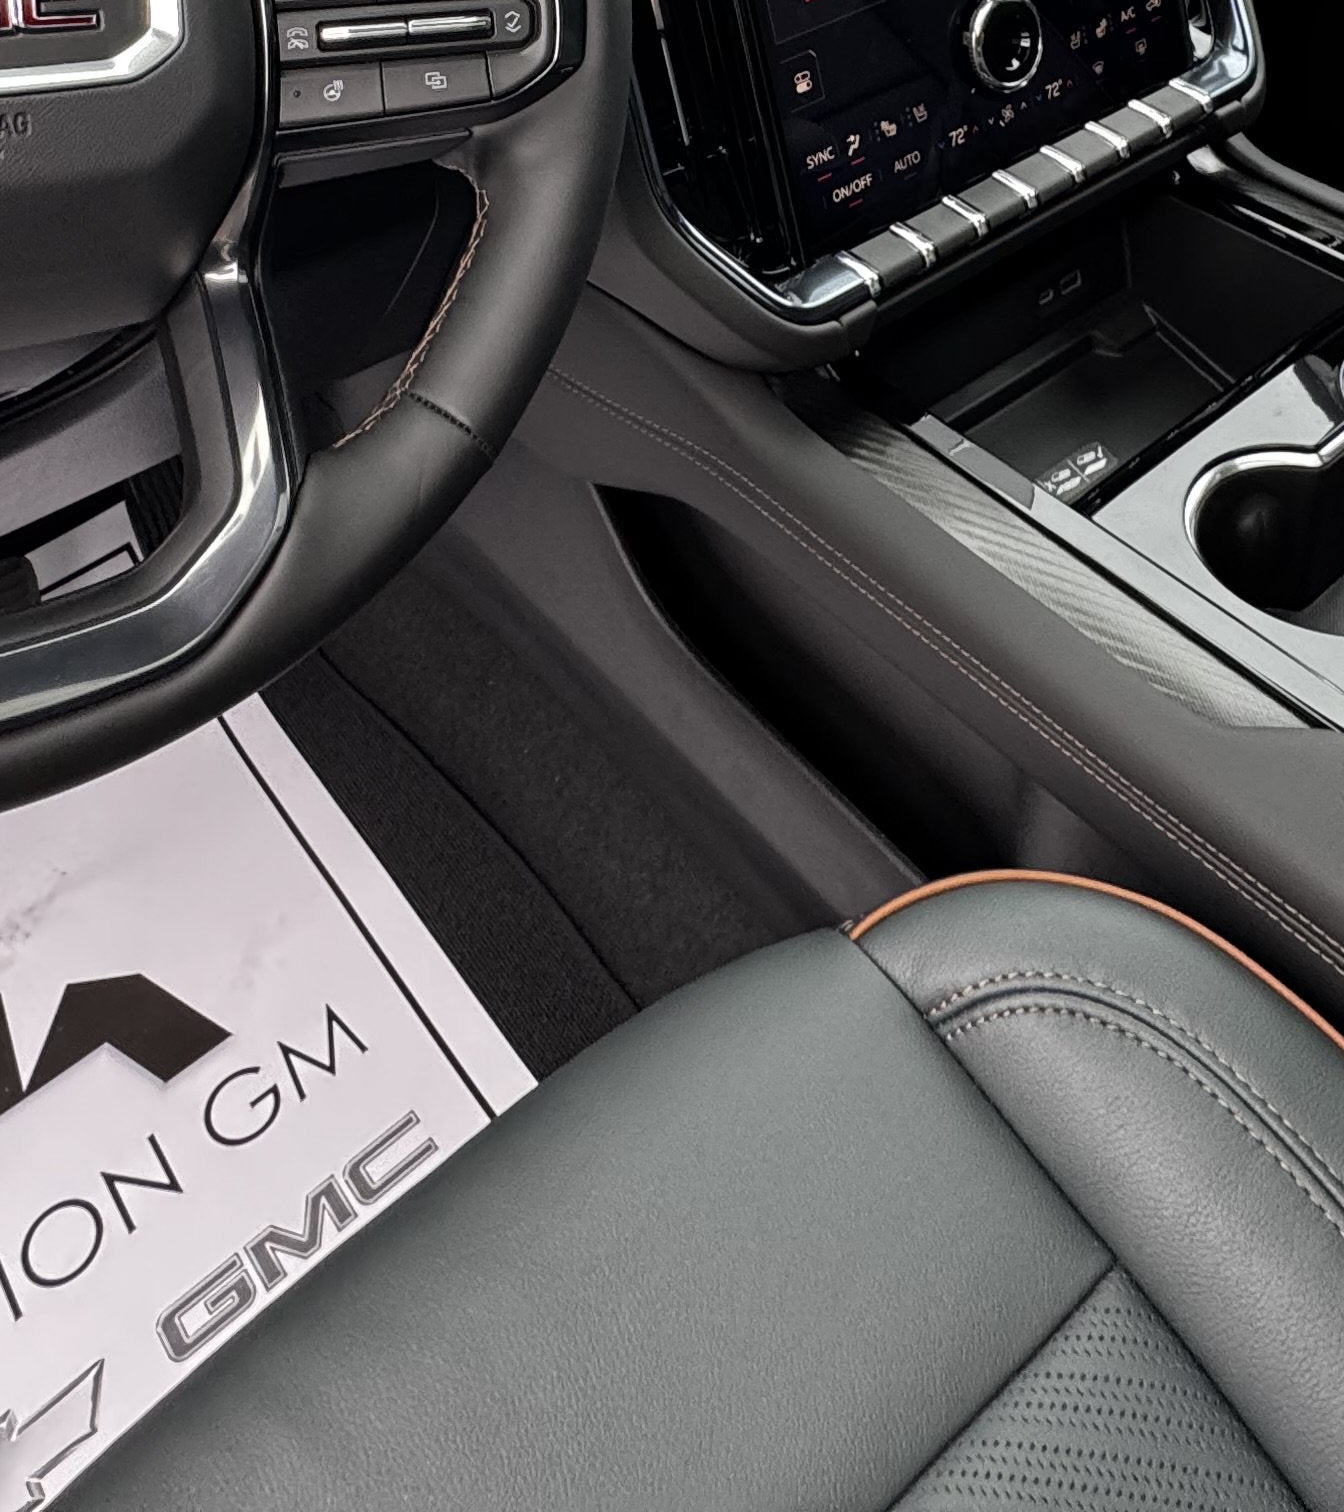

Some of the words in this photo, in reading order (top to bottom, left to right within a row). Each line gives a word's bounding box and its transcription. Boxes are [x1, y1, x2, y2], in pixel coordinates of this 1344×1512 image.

[806, 146, 835, 170] SYNC
[894, 150, 921, 174] AUTO
[832, 173, 873, 204] ON/OFF
[203, 1003, 369, 1148] GM
[154, 1108, 440, 1364] GMC
